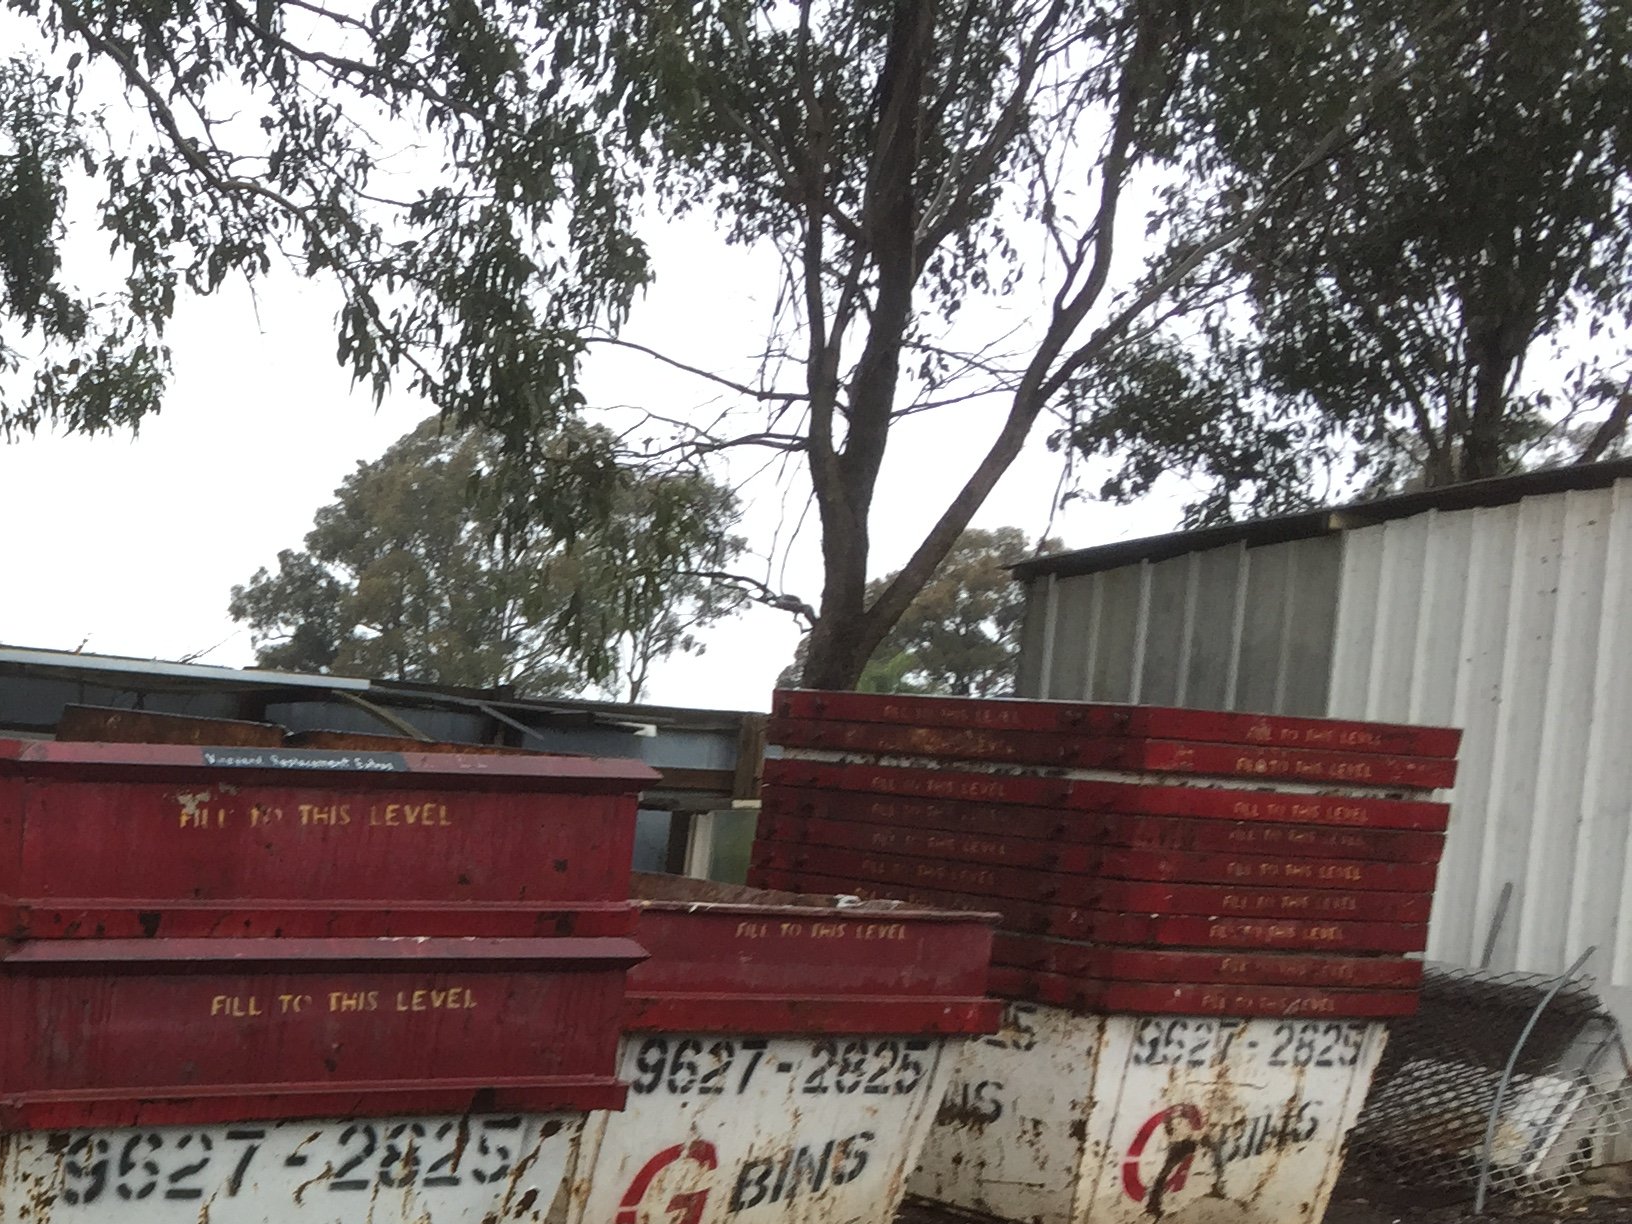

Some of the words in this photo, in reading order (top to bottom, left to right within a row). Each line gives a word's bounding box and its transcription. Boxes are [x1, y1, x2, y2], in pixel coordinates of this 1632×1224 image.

[298, 803, 351, 827] THIS
[369, 802, 452, 827] LEVEL
[734, 920, 769, 941] FILL
[779, 922, 803, 939] TO
[810, 921, 848, 940] THIS
[855, 922, 907, 941] LEVEL
[209, 994, 264, 1018] FILL
[277, 993, 313, 1014] TO
[327, 990, 380, 1013] THIS
[395, 987, 479, 1012] LEVEL
[630, 1036, 933, 1096] 9627-2825
[64, 1115, 522, 1205] 9627-2825
[727, 1130, 876, 1214] BINS
